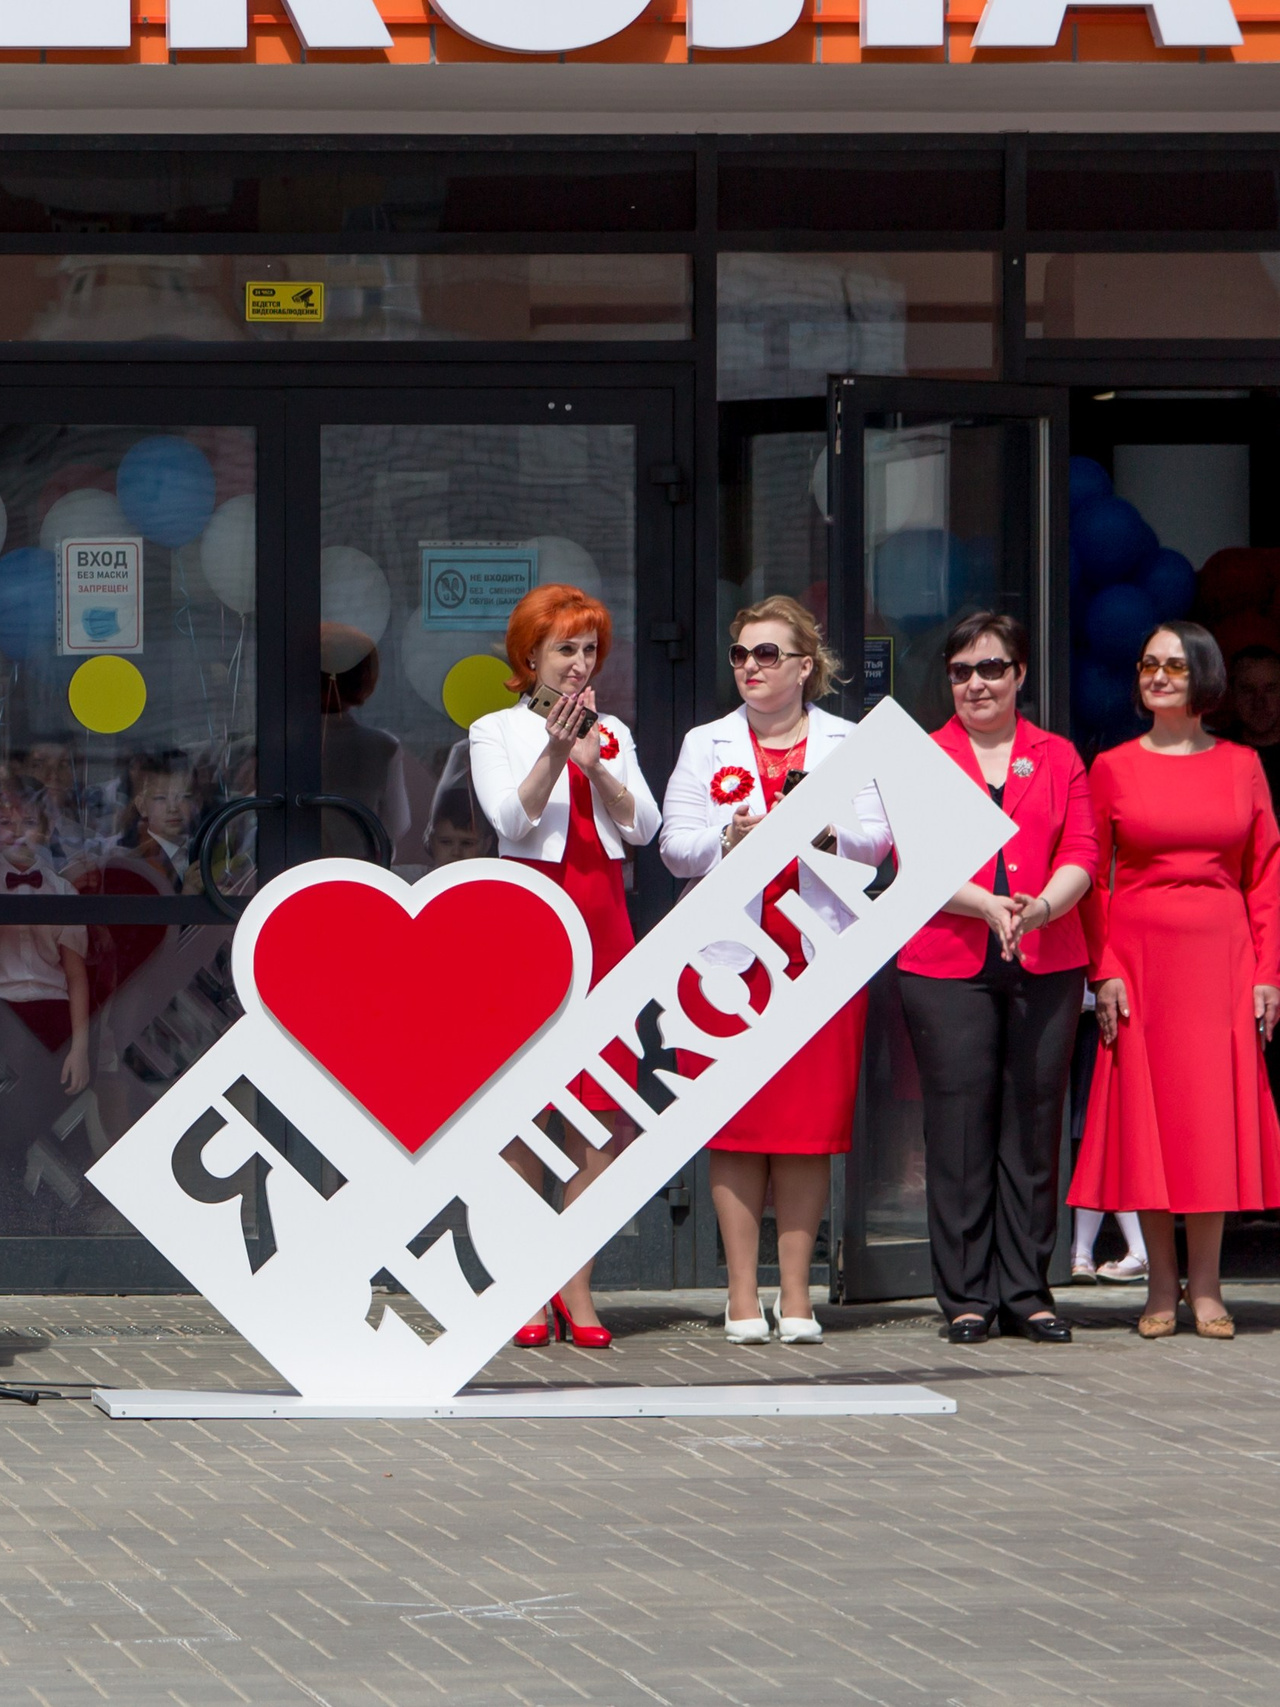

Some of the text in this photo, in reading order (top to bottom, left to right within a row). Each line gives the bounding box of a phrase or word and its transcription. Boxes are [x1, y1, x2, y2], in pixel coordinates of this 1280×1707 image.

[252, 308, 318, 316] ВИДЕОНАБЛЮДЕНИЕ
[77, 551, 128, 569] ВХОД
[77, 571, 128, 579] БЕЗ МАСКИ
[470, 574, 525, 583] НЕ ВХОДИТЬ
[78, 585, 128, 594] ЗАПРЕЩЕН
[489, 586, 525, 595] СМЕННОЙ
[469, 597, 494, 605] ОБУВИ
[363, 778, 901, 1347] 17 ШКОЛУ
[171, 1074, 349, 1275] Я
